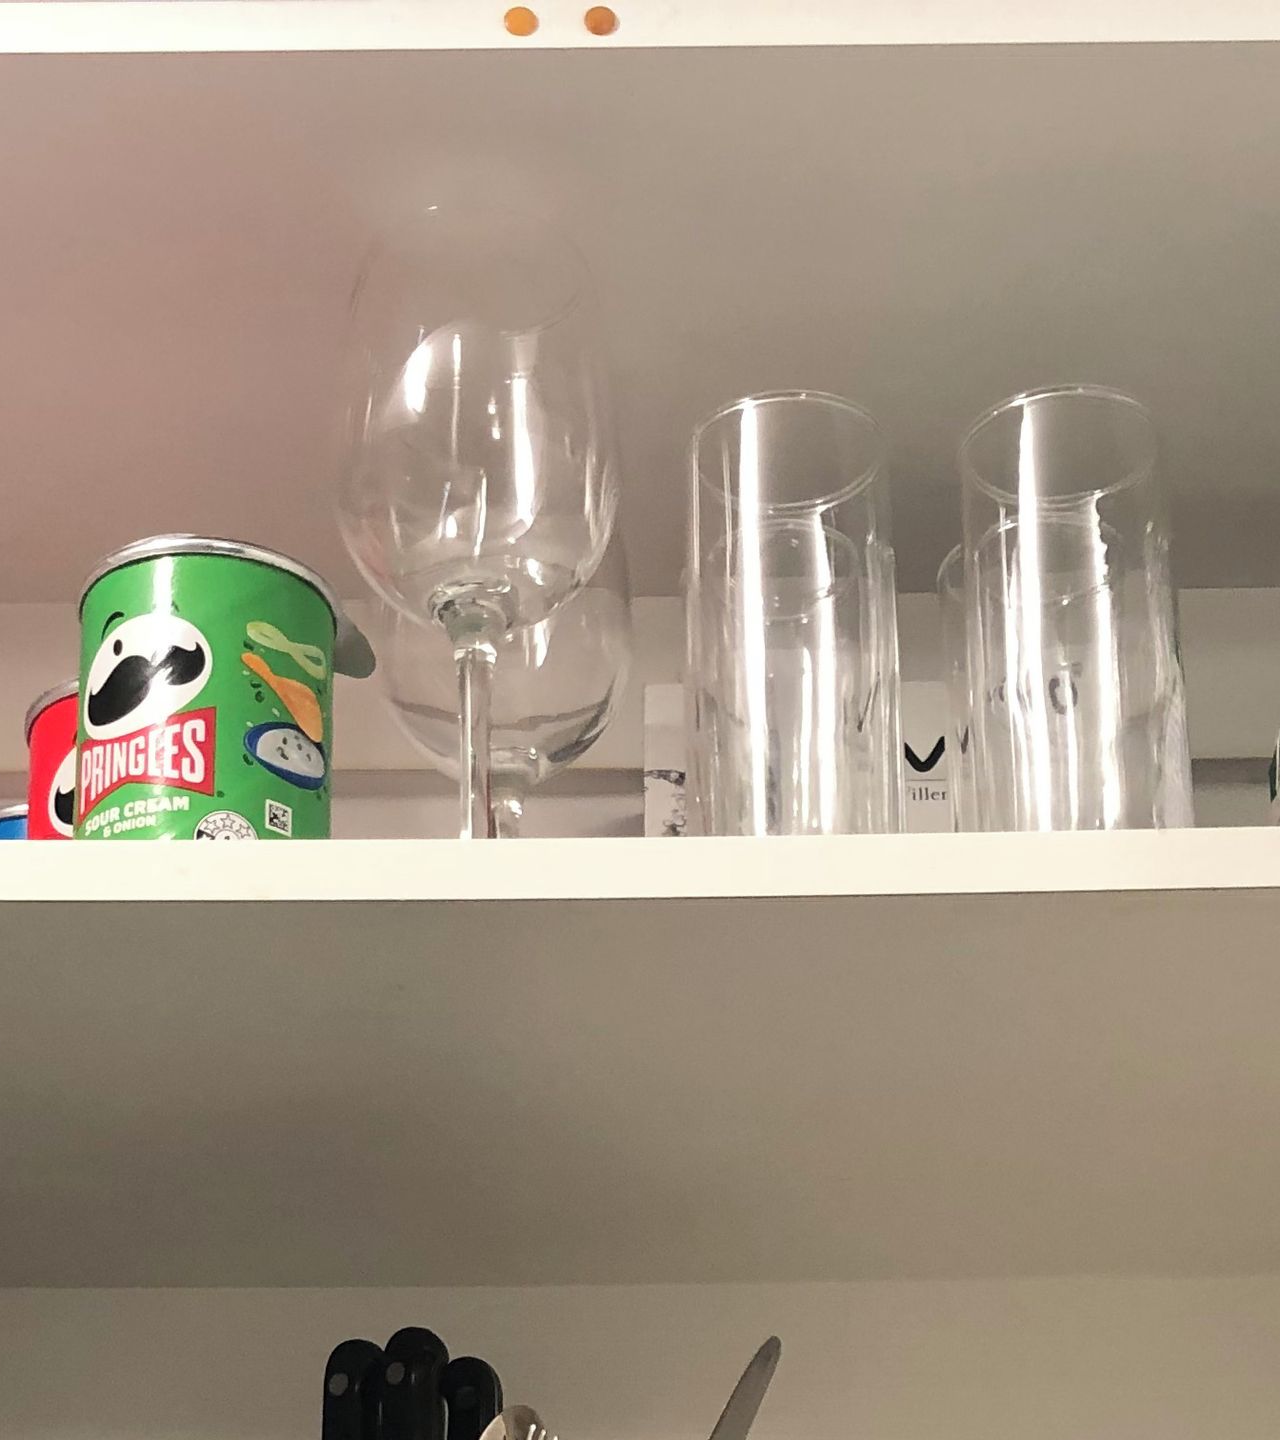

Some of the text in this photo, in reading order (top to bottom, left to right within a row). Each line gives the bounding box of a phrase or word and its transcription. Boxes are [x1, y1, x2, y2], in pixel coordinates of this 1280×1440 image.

[85, 795, 190, 836] SOUR CREAM
[102, 815, 156, 838] & ONION
